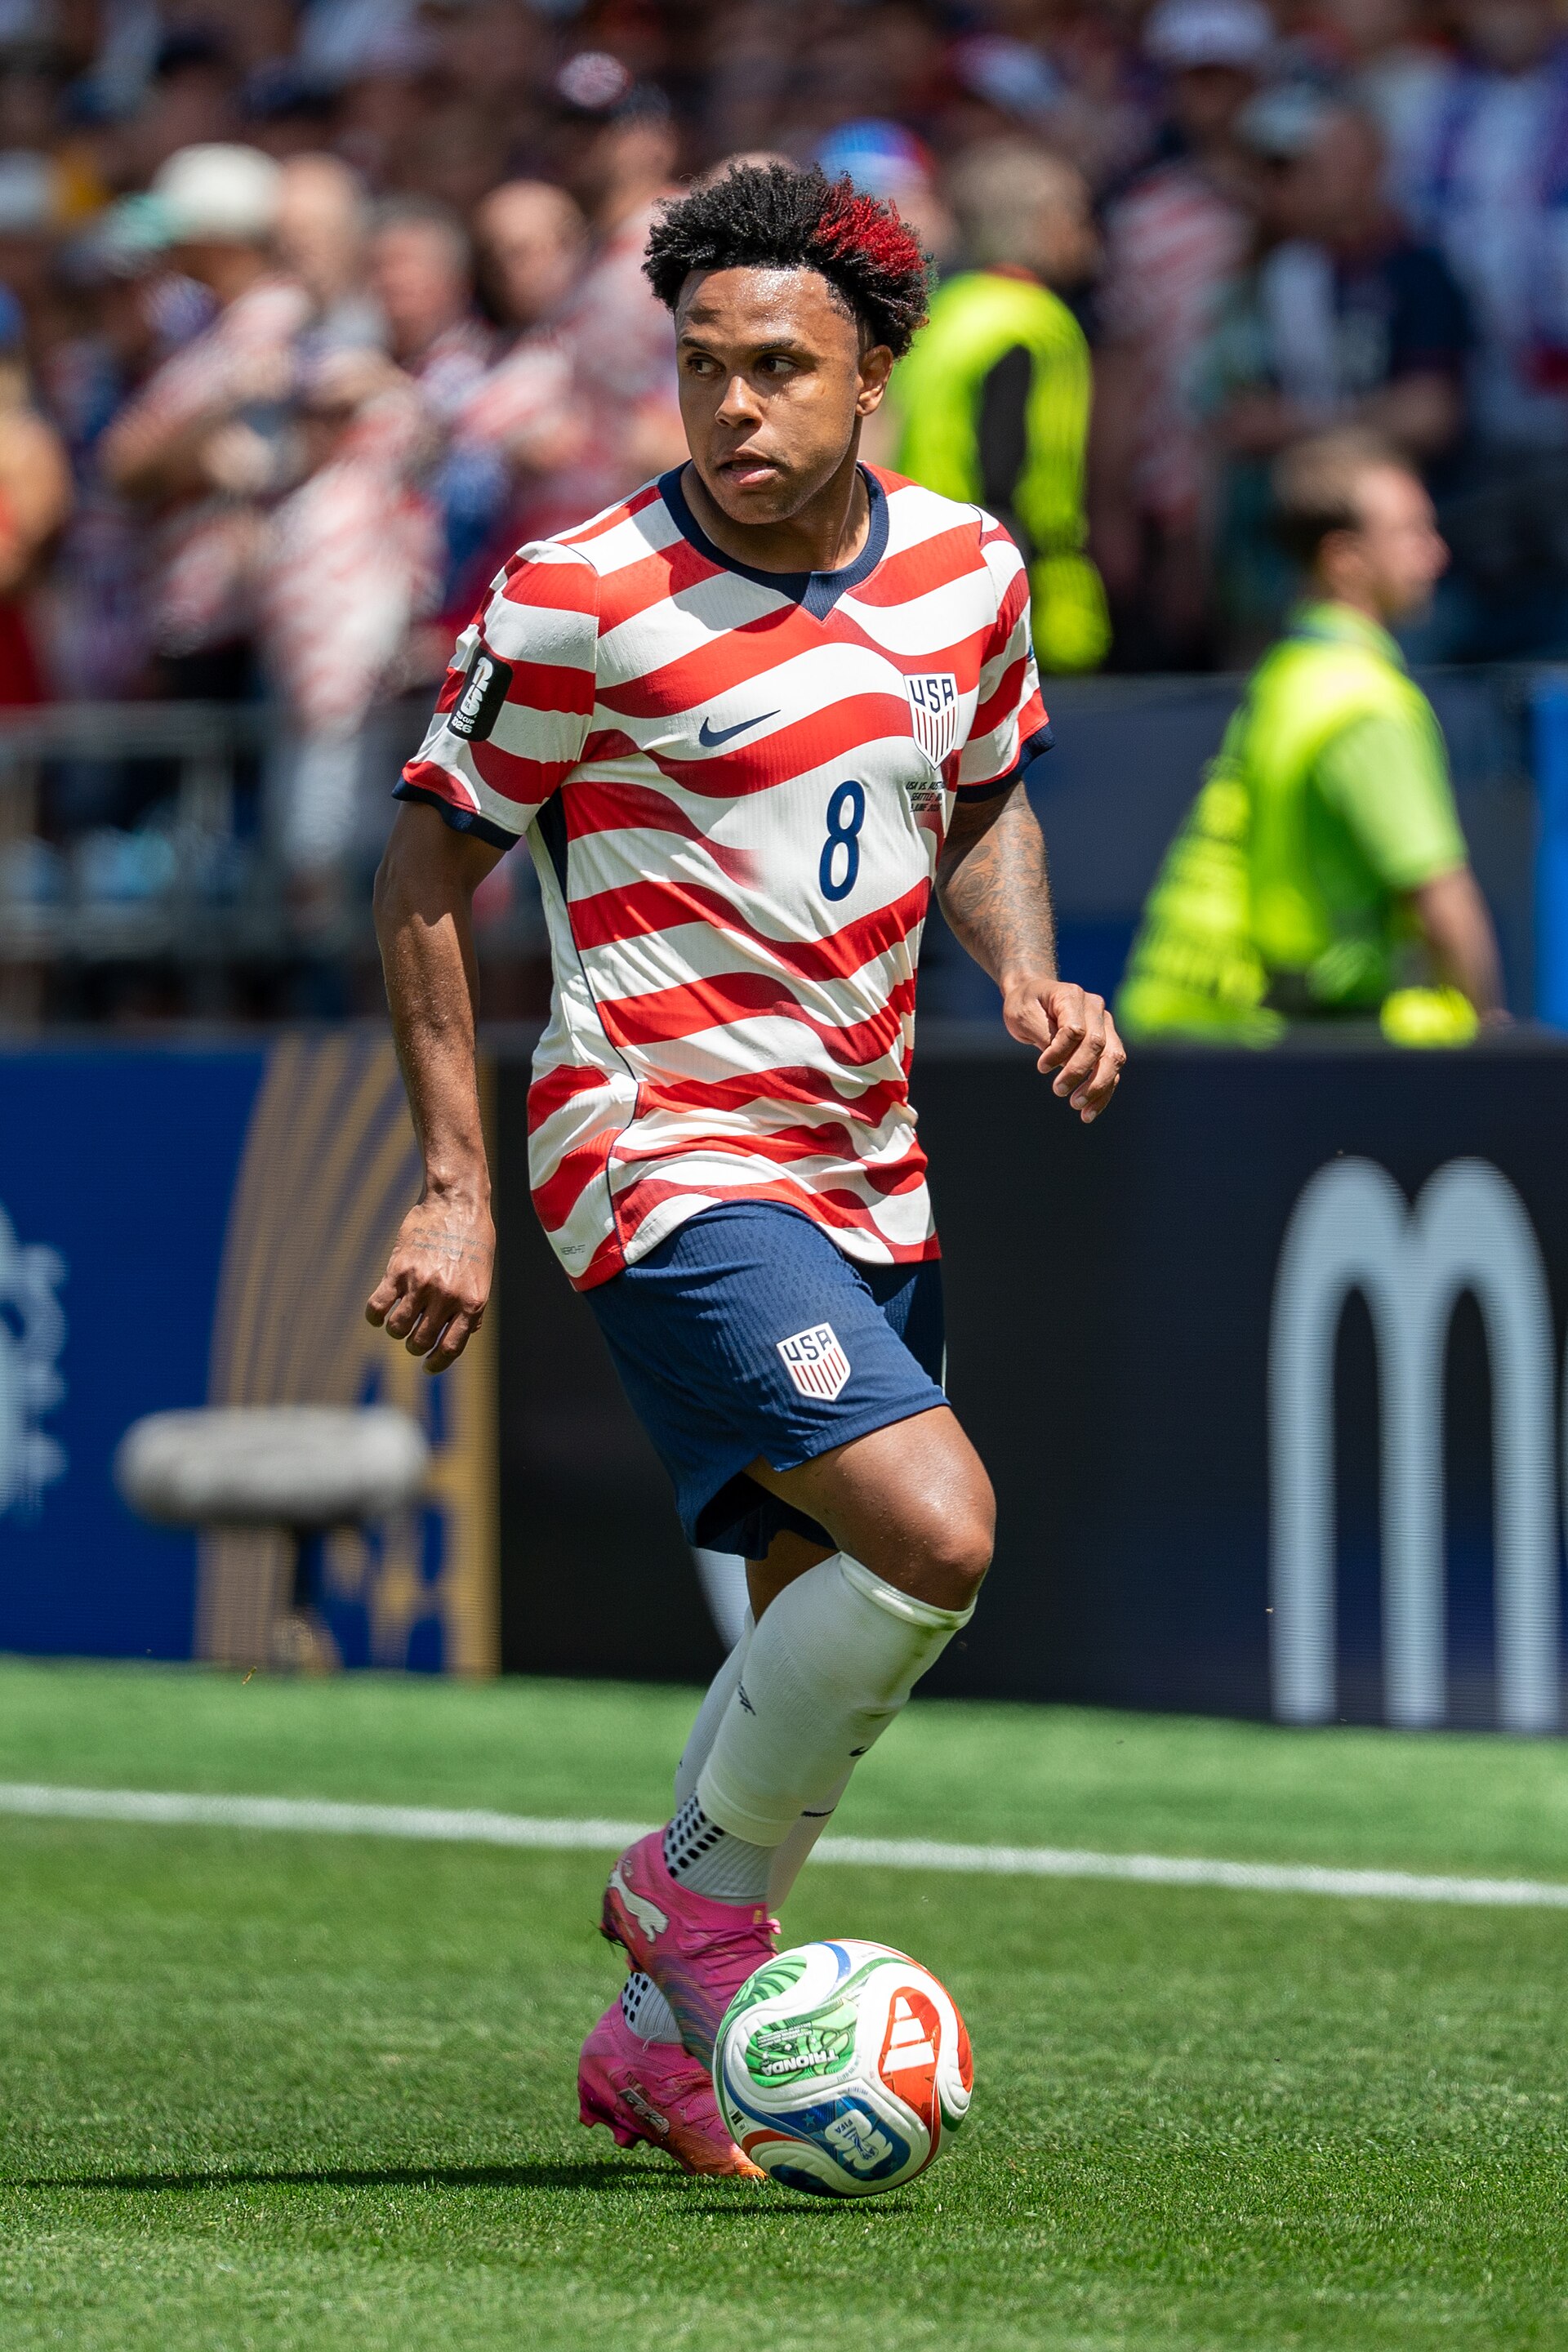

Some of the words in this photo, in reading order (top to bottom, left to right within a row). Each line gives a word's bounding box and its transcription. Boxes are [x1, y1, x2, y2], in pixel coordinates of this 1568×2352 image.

[909, 679, 955, 713] USA
[462, 716, 475, 724] CUP
[906, 781, 919, 790] USA
[819, 780, 865, 902] 8
[783, 1329, 832, 1361] USA
[1267, 1155, 1568, 1730] m
[760, 2048, 840, 2076] TRIONDA
[835, 2118, 853, 2134] FIFA
